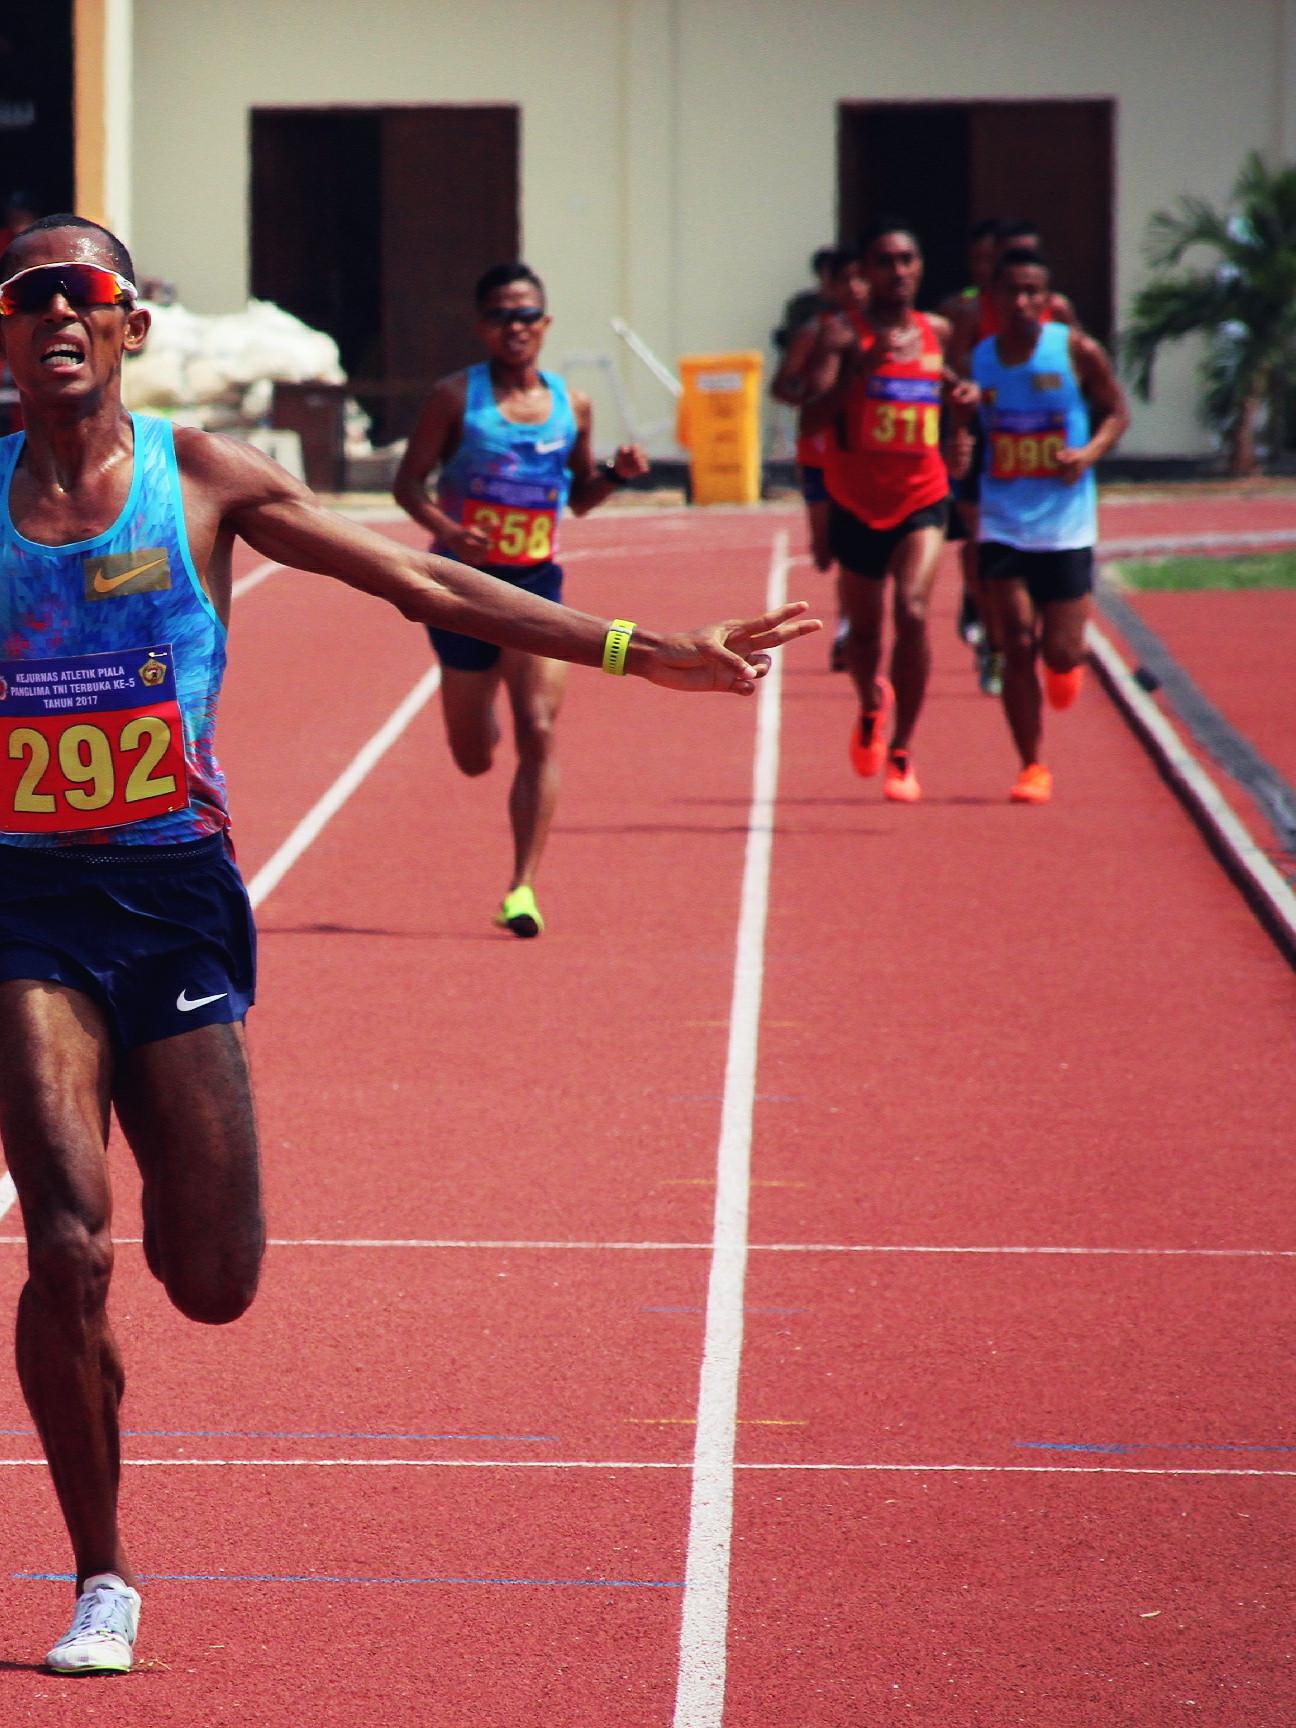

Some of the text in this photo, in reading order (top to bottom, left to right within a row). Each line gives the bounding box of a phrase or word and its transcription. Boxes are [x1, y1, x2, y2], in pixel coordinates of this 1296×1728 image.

[16, 666, 125, 683] KEJURNAS ATLETIK PIALA
[10, 678, 136, 697] PANGLIMA TNI TERBUKA KE-5
[43, 695, 98, 709] TAHUN 2017
[8, 716, 177, 813] 292
